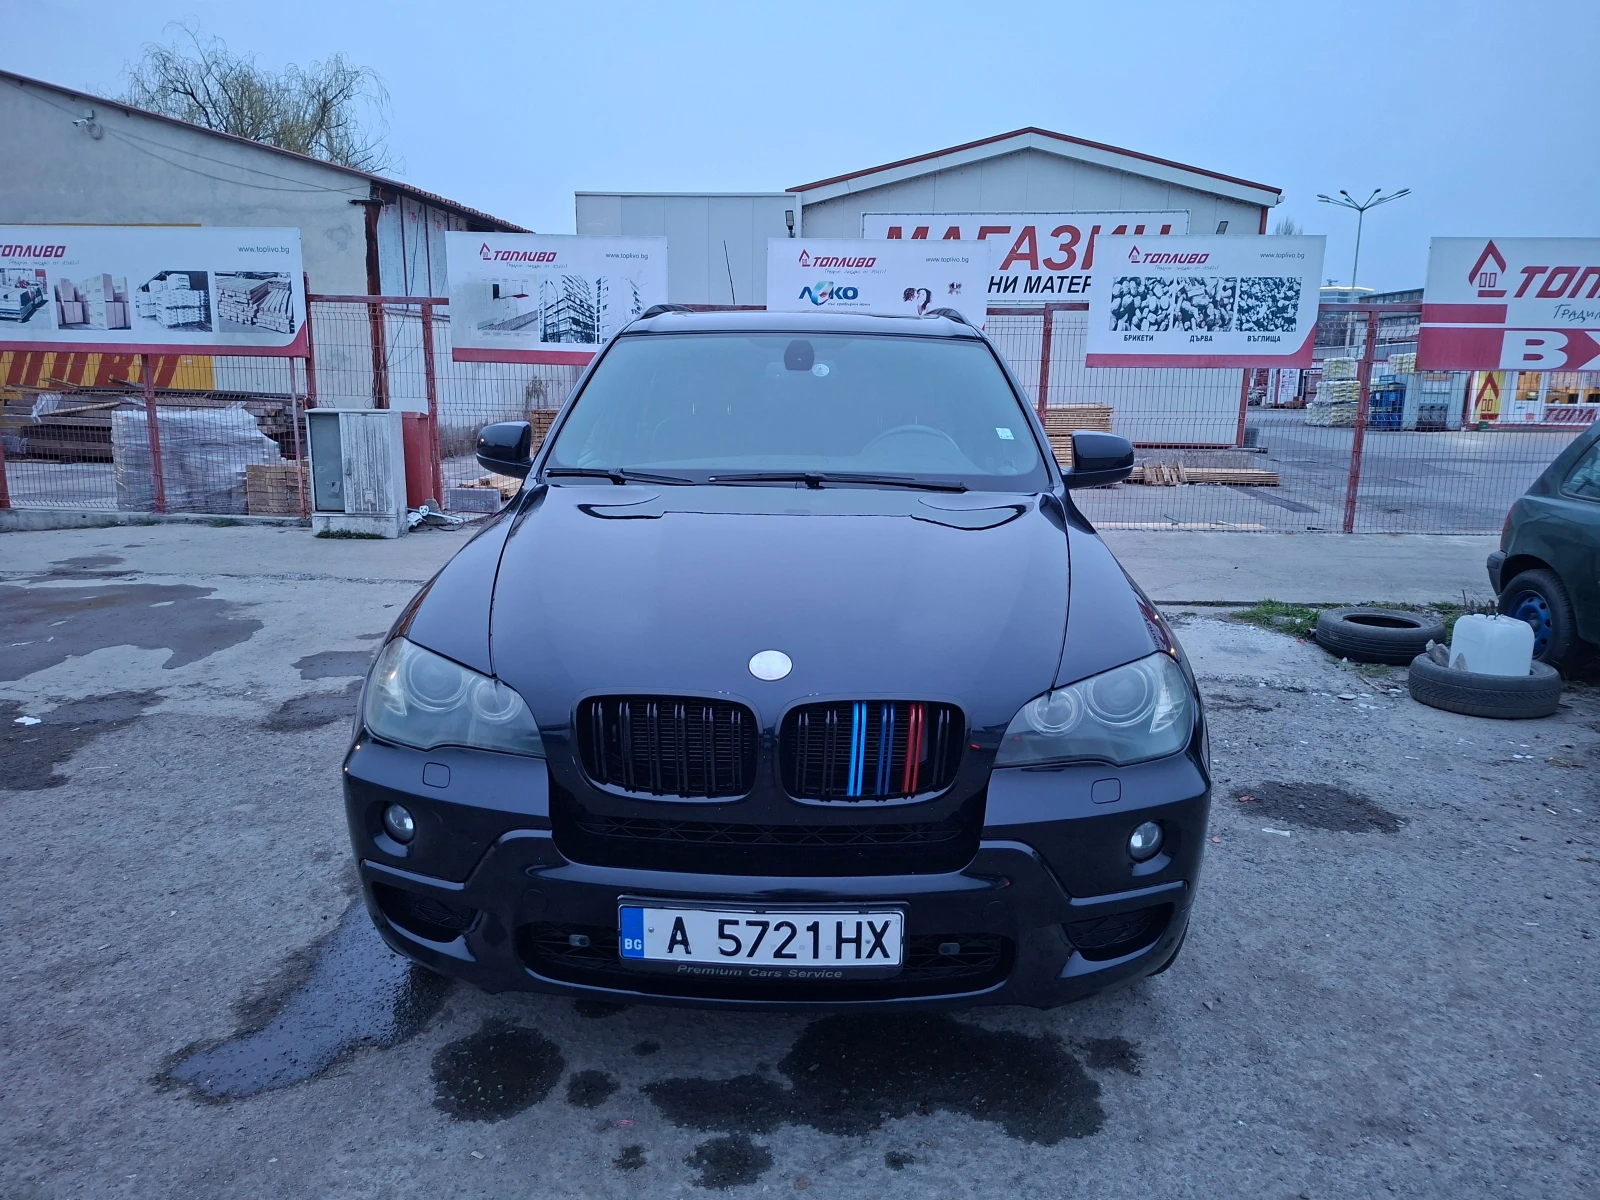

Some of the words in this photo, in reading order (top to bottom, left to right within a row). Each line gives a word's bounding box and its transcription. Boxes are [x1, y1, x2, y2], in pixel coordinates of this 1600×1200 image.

[0, 245, 66, 257] ОПЛИВО
[238, 246, 290, 254] www.toplivo.bg
[887, 225, 1171, 270] ГАЗИ
[494, 251, 557, 262] ТОПЛИВО
[605, 252, 649, 260] www.toplivo.bg
[1142, 253, 1210, 264] ТОПЛИВО
[813, 257, 877, 267] ТОПЛИВО
[1514, 266, 1600, 298] ТОП
[1124, 334, 1154, 342] БРИКЕТИ
[1247, 335, 1281, 343] ВЪГЛИЩА
[667, 916, 692, 954] A
[624, 938, 642, 950] BG
[677, 964, 743, 976] Premium
[748, 968, 782, 978] Cars
[788, 968, 843, 978] Service
